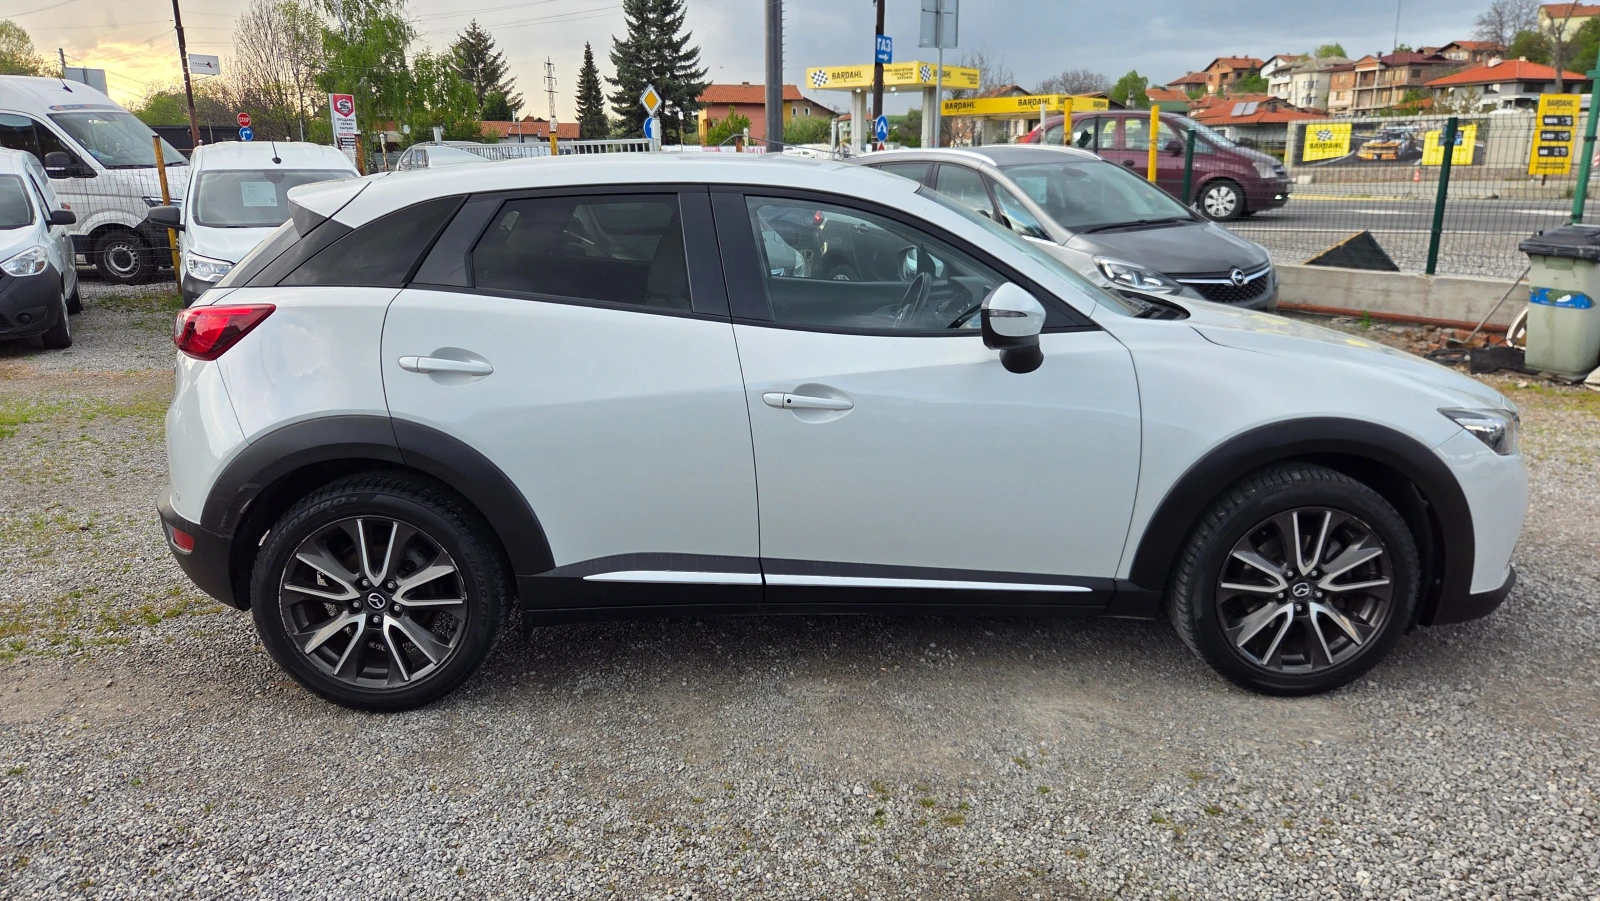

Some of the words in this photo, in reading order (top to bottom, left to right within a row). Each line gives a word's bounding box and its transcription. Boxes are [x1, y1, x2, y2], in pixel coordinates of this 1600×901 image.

[877, 38, 891, 52] ГАЗ
[832, 71, 863, 82] BARDAHL
[945, 102, 976, 112] BARDAHL
[1547, 99, 1573, 109] BARDAHL
[1309, 143, 1344, 152] BARDAHL
